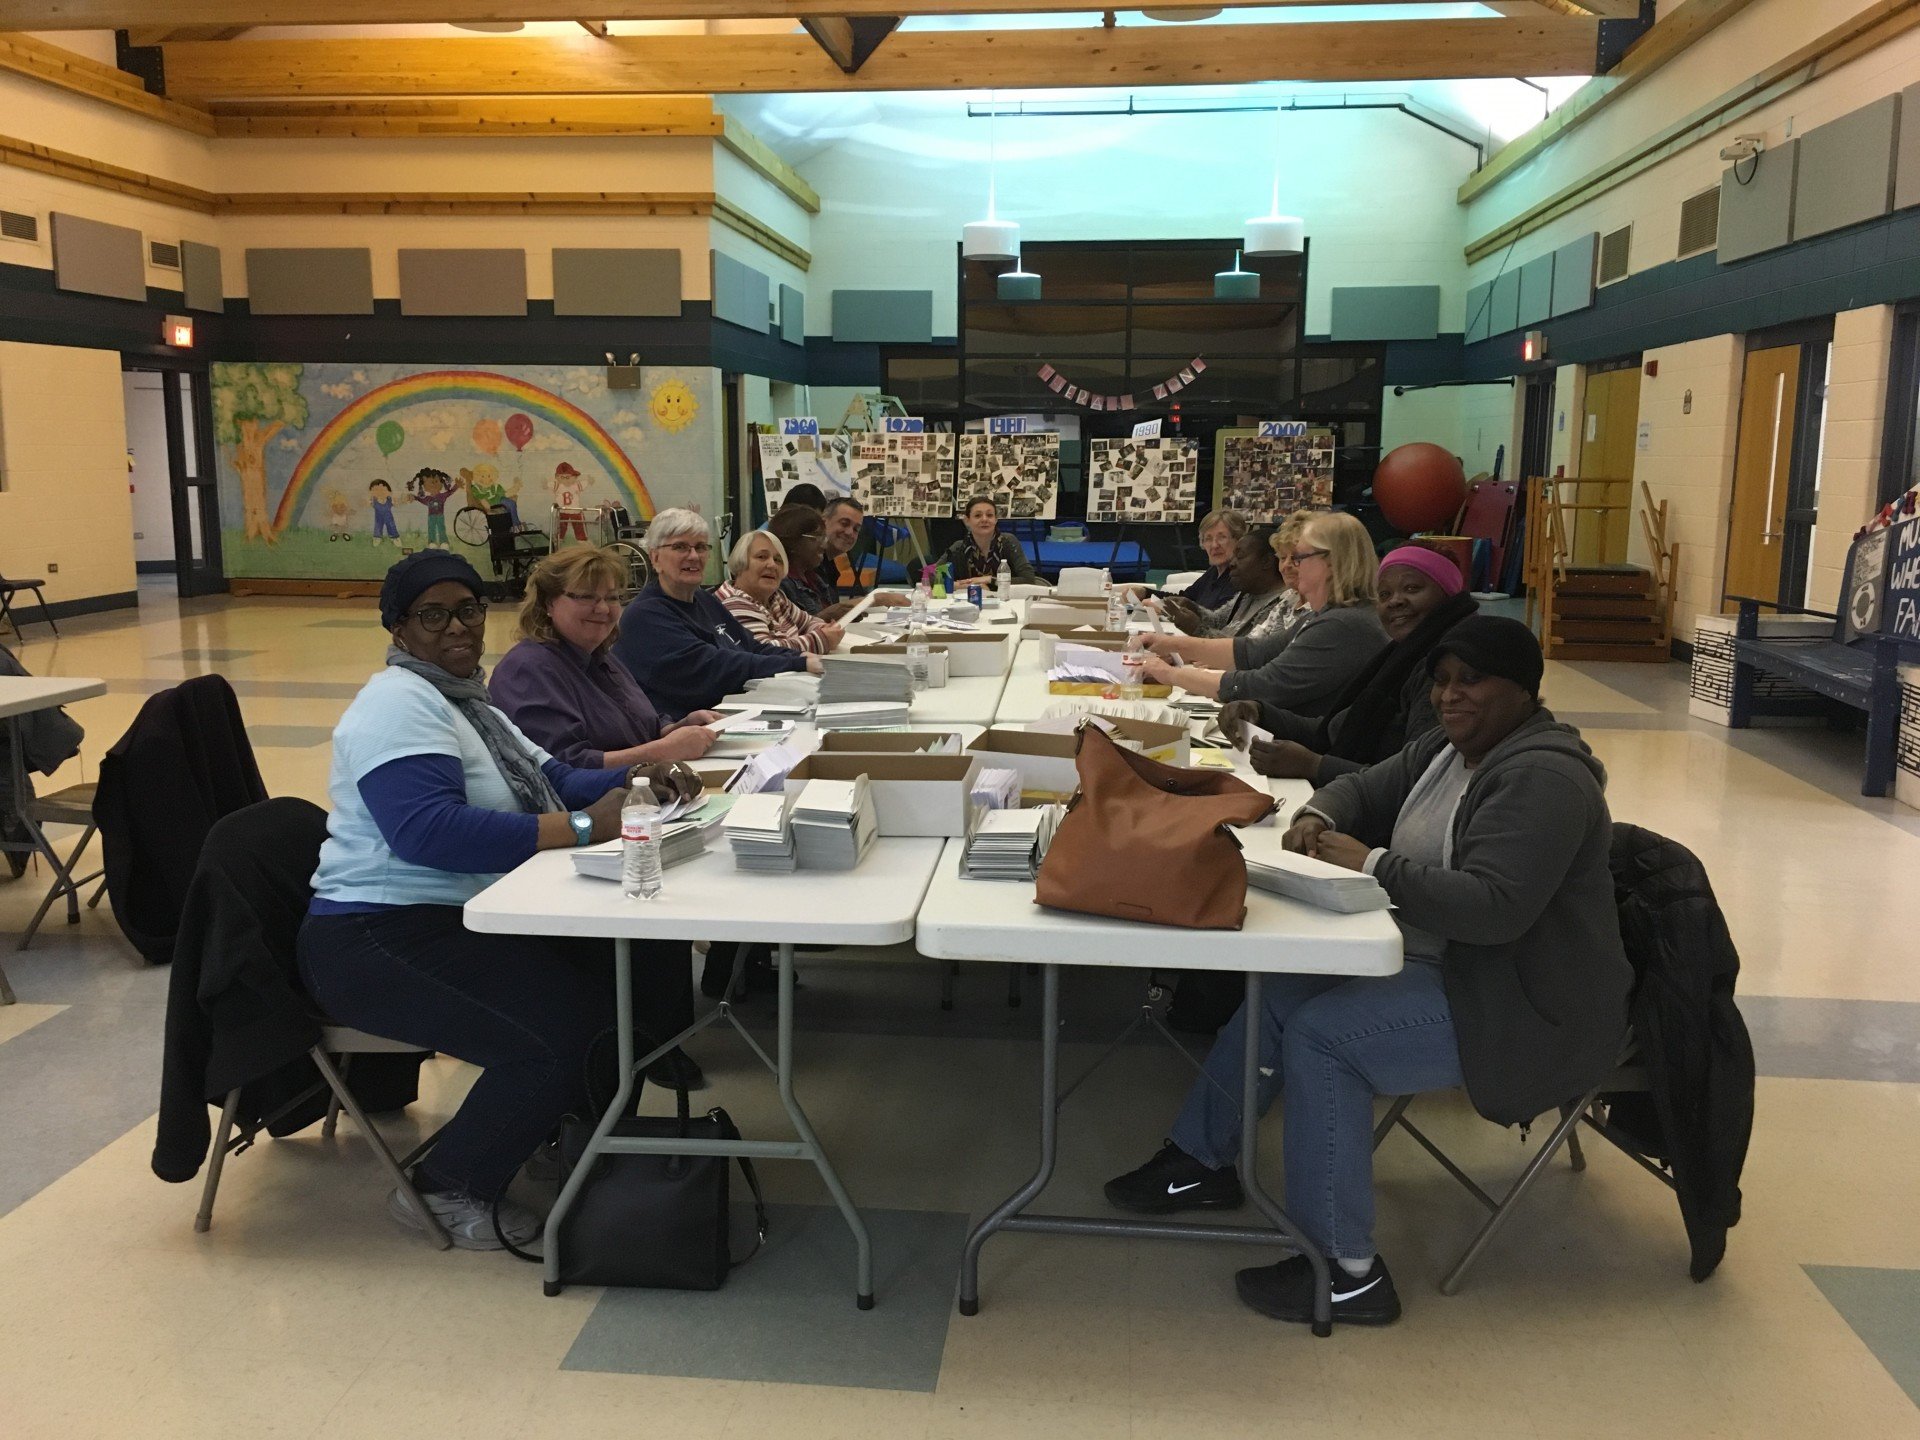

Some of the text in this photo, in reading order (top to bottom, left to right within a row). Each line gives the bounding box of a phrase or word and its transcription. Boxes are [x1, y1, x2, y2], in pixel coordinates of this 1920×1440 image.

[1153, 357, 1207, 400] ZON
[1135, 423, 1159, 437] 1990
[1260, 422, 1306, 437] 2000
[562, 491, 573, 505] B
[1897, 519, 1920, 556] MU
